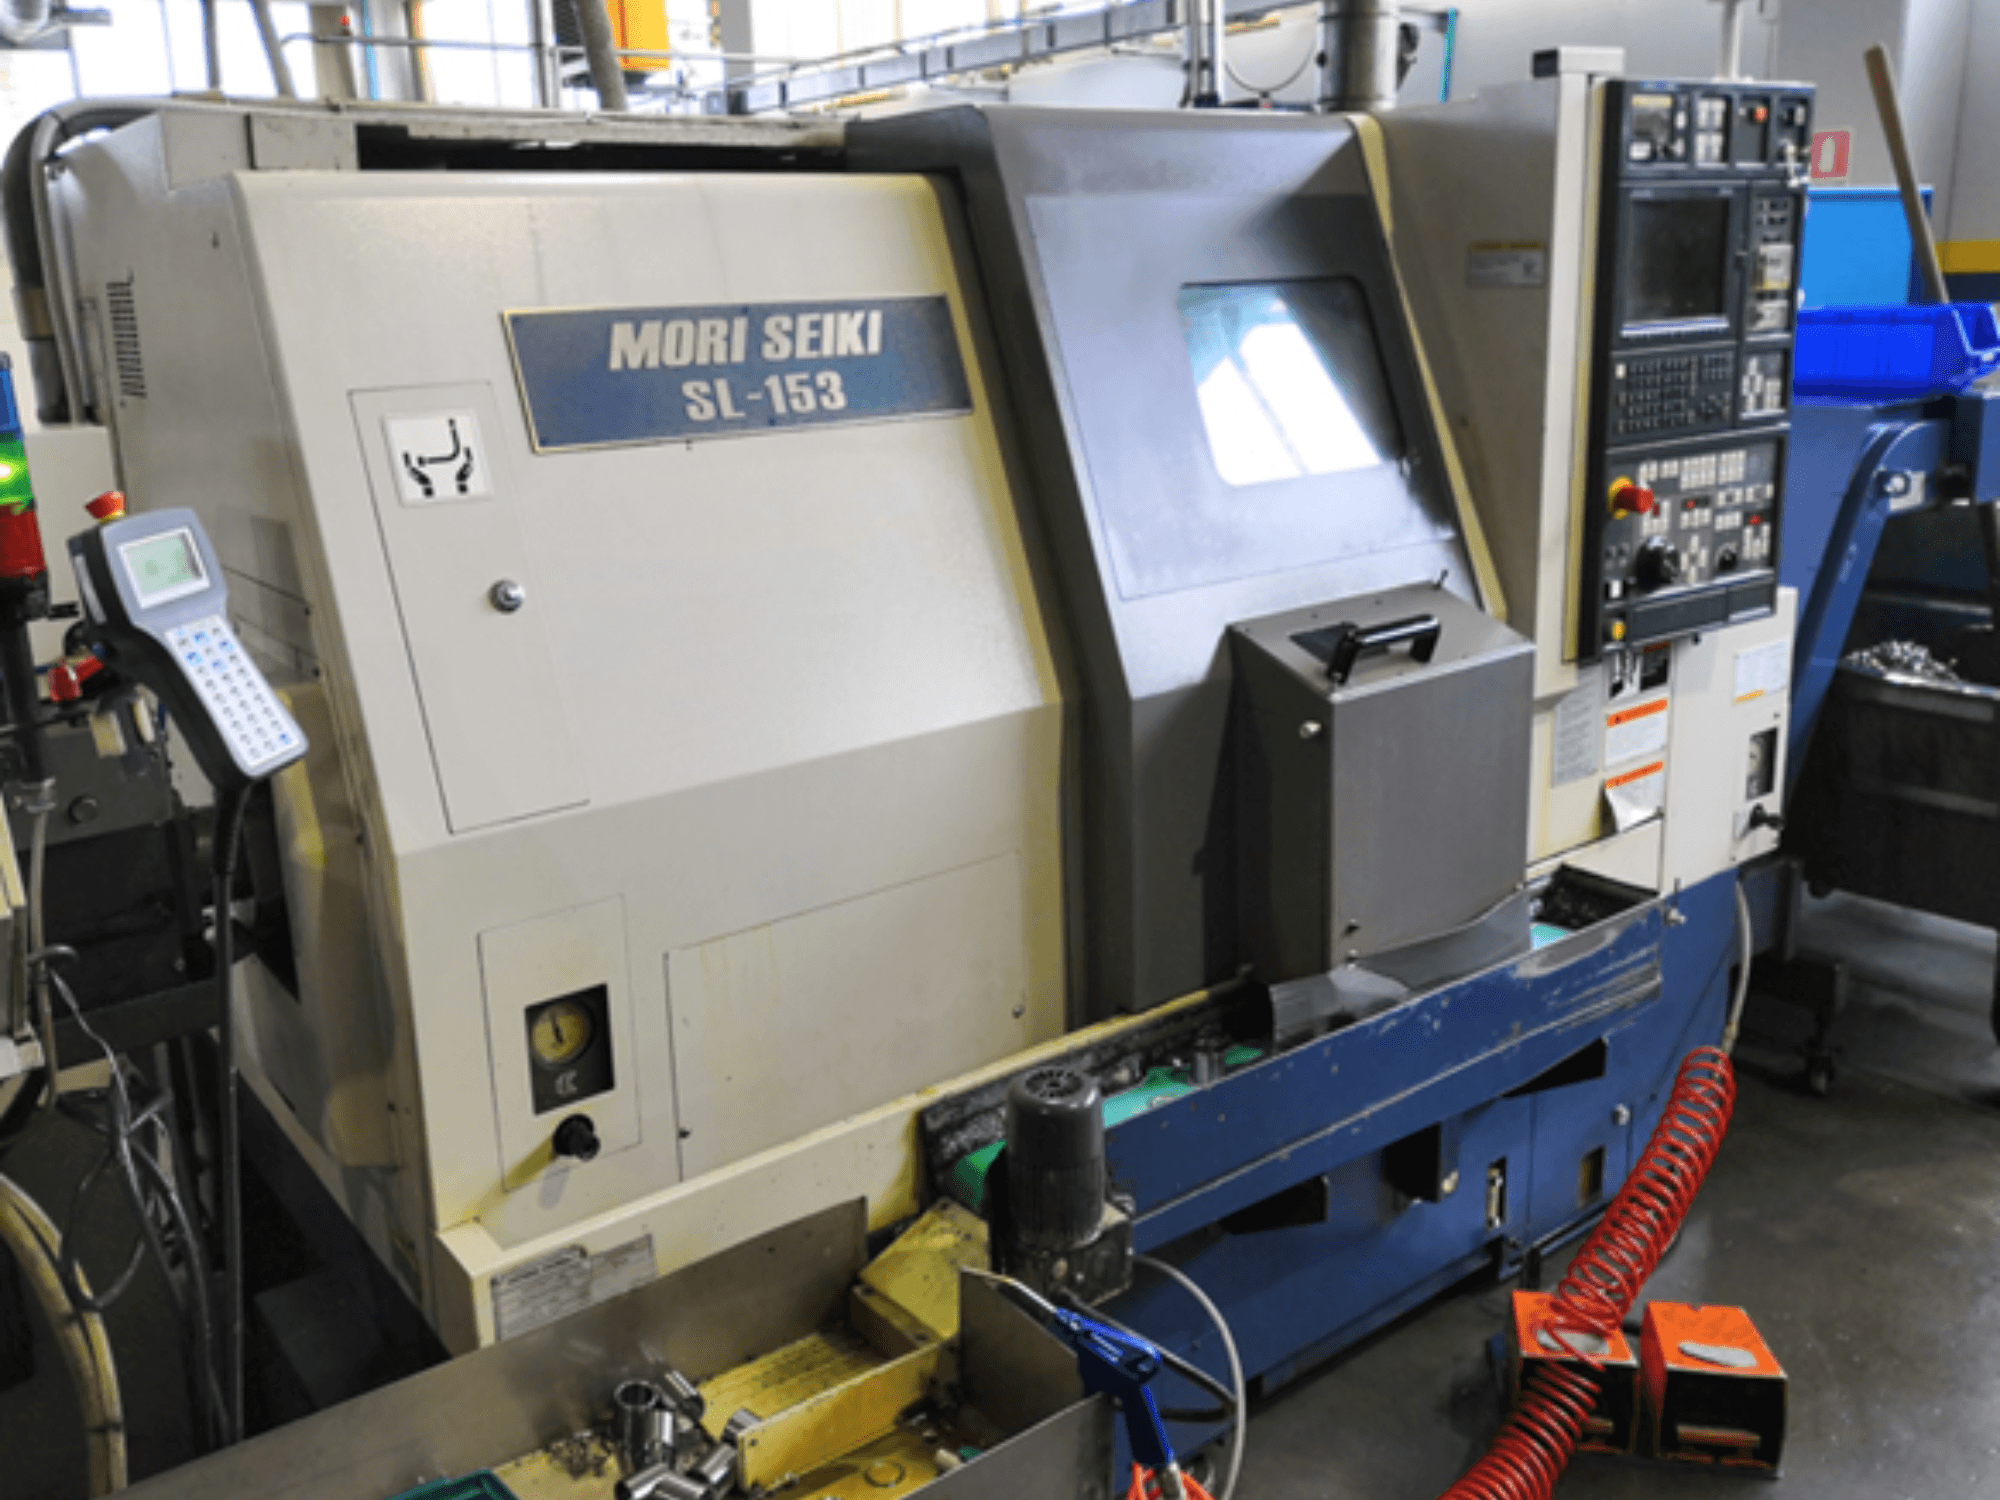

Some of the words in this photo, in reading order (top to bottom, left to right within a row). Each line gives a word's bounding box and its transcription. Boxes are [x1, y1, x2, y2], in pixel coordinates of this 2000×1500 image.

[609, 316, 748, 371] MORI
[761, 309, 883, 362] SEIKI
[682, 370, 848, 421] SL-153
